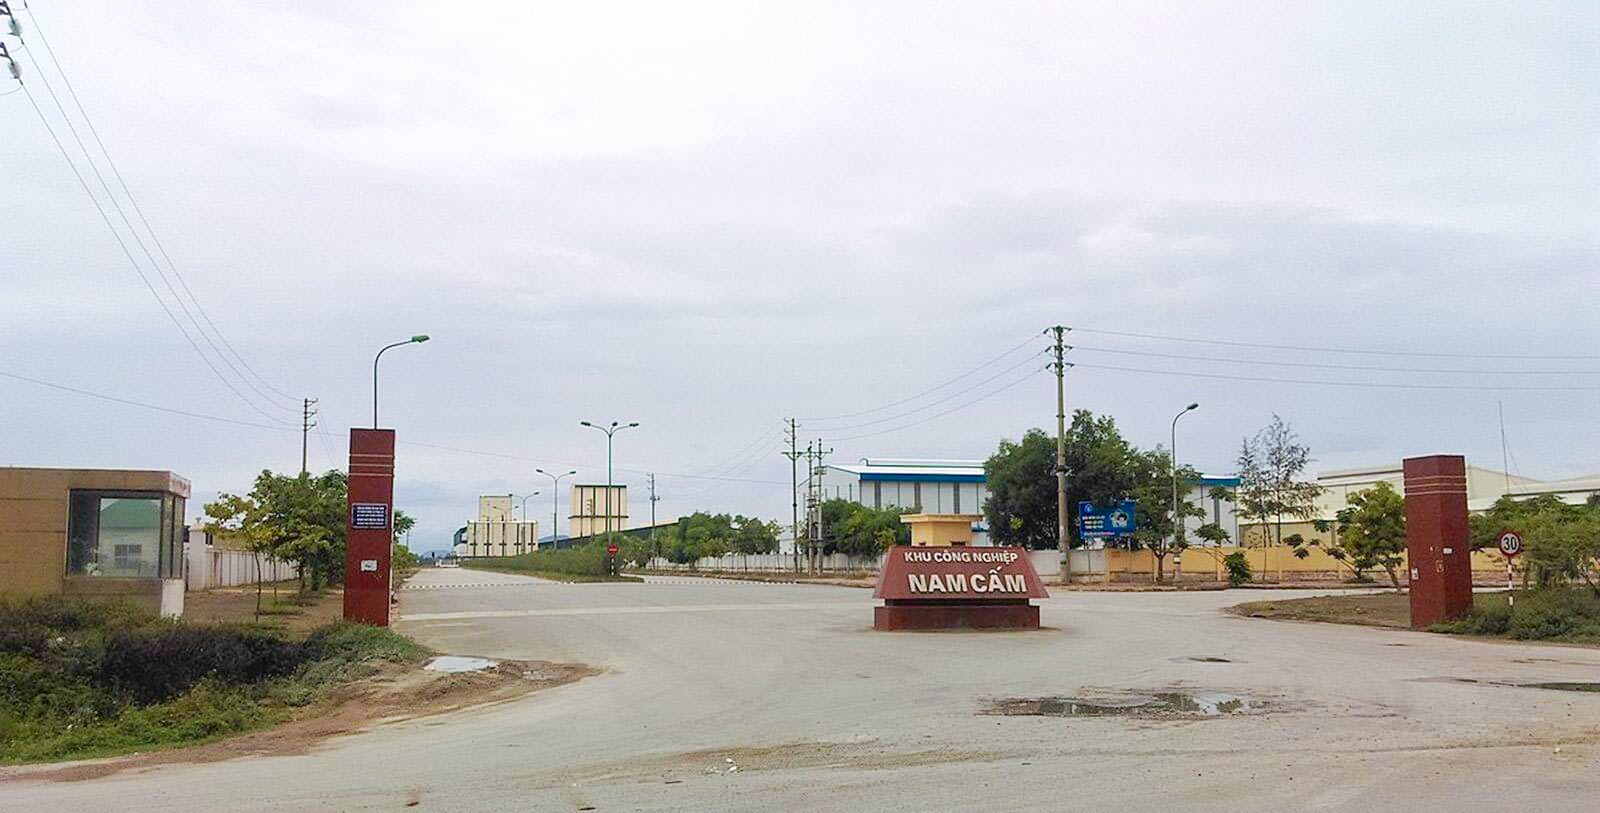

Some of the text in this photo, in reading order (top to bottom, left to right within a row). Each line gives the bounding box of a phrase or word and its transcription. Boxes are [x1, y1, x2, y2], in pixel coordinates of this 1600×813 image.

[1504, 537, 1516, 550] 30
[904, 549, 1018, 565] KHU CÔNG NGHIỆP
[908, 566, 1027, 593] NAM CẤM
